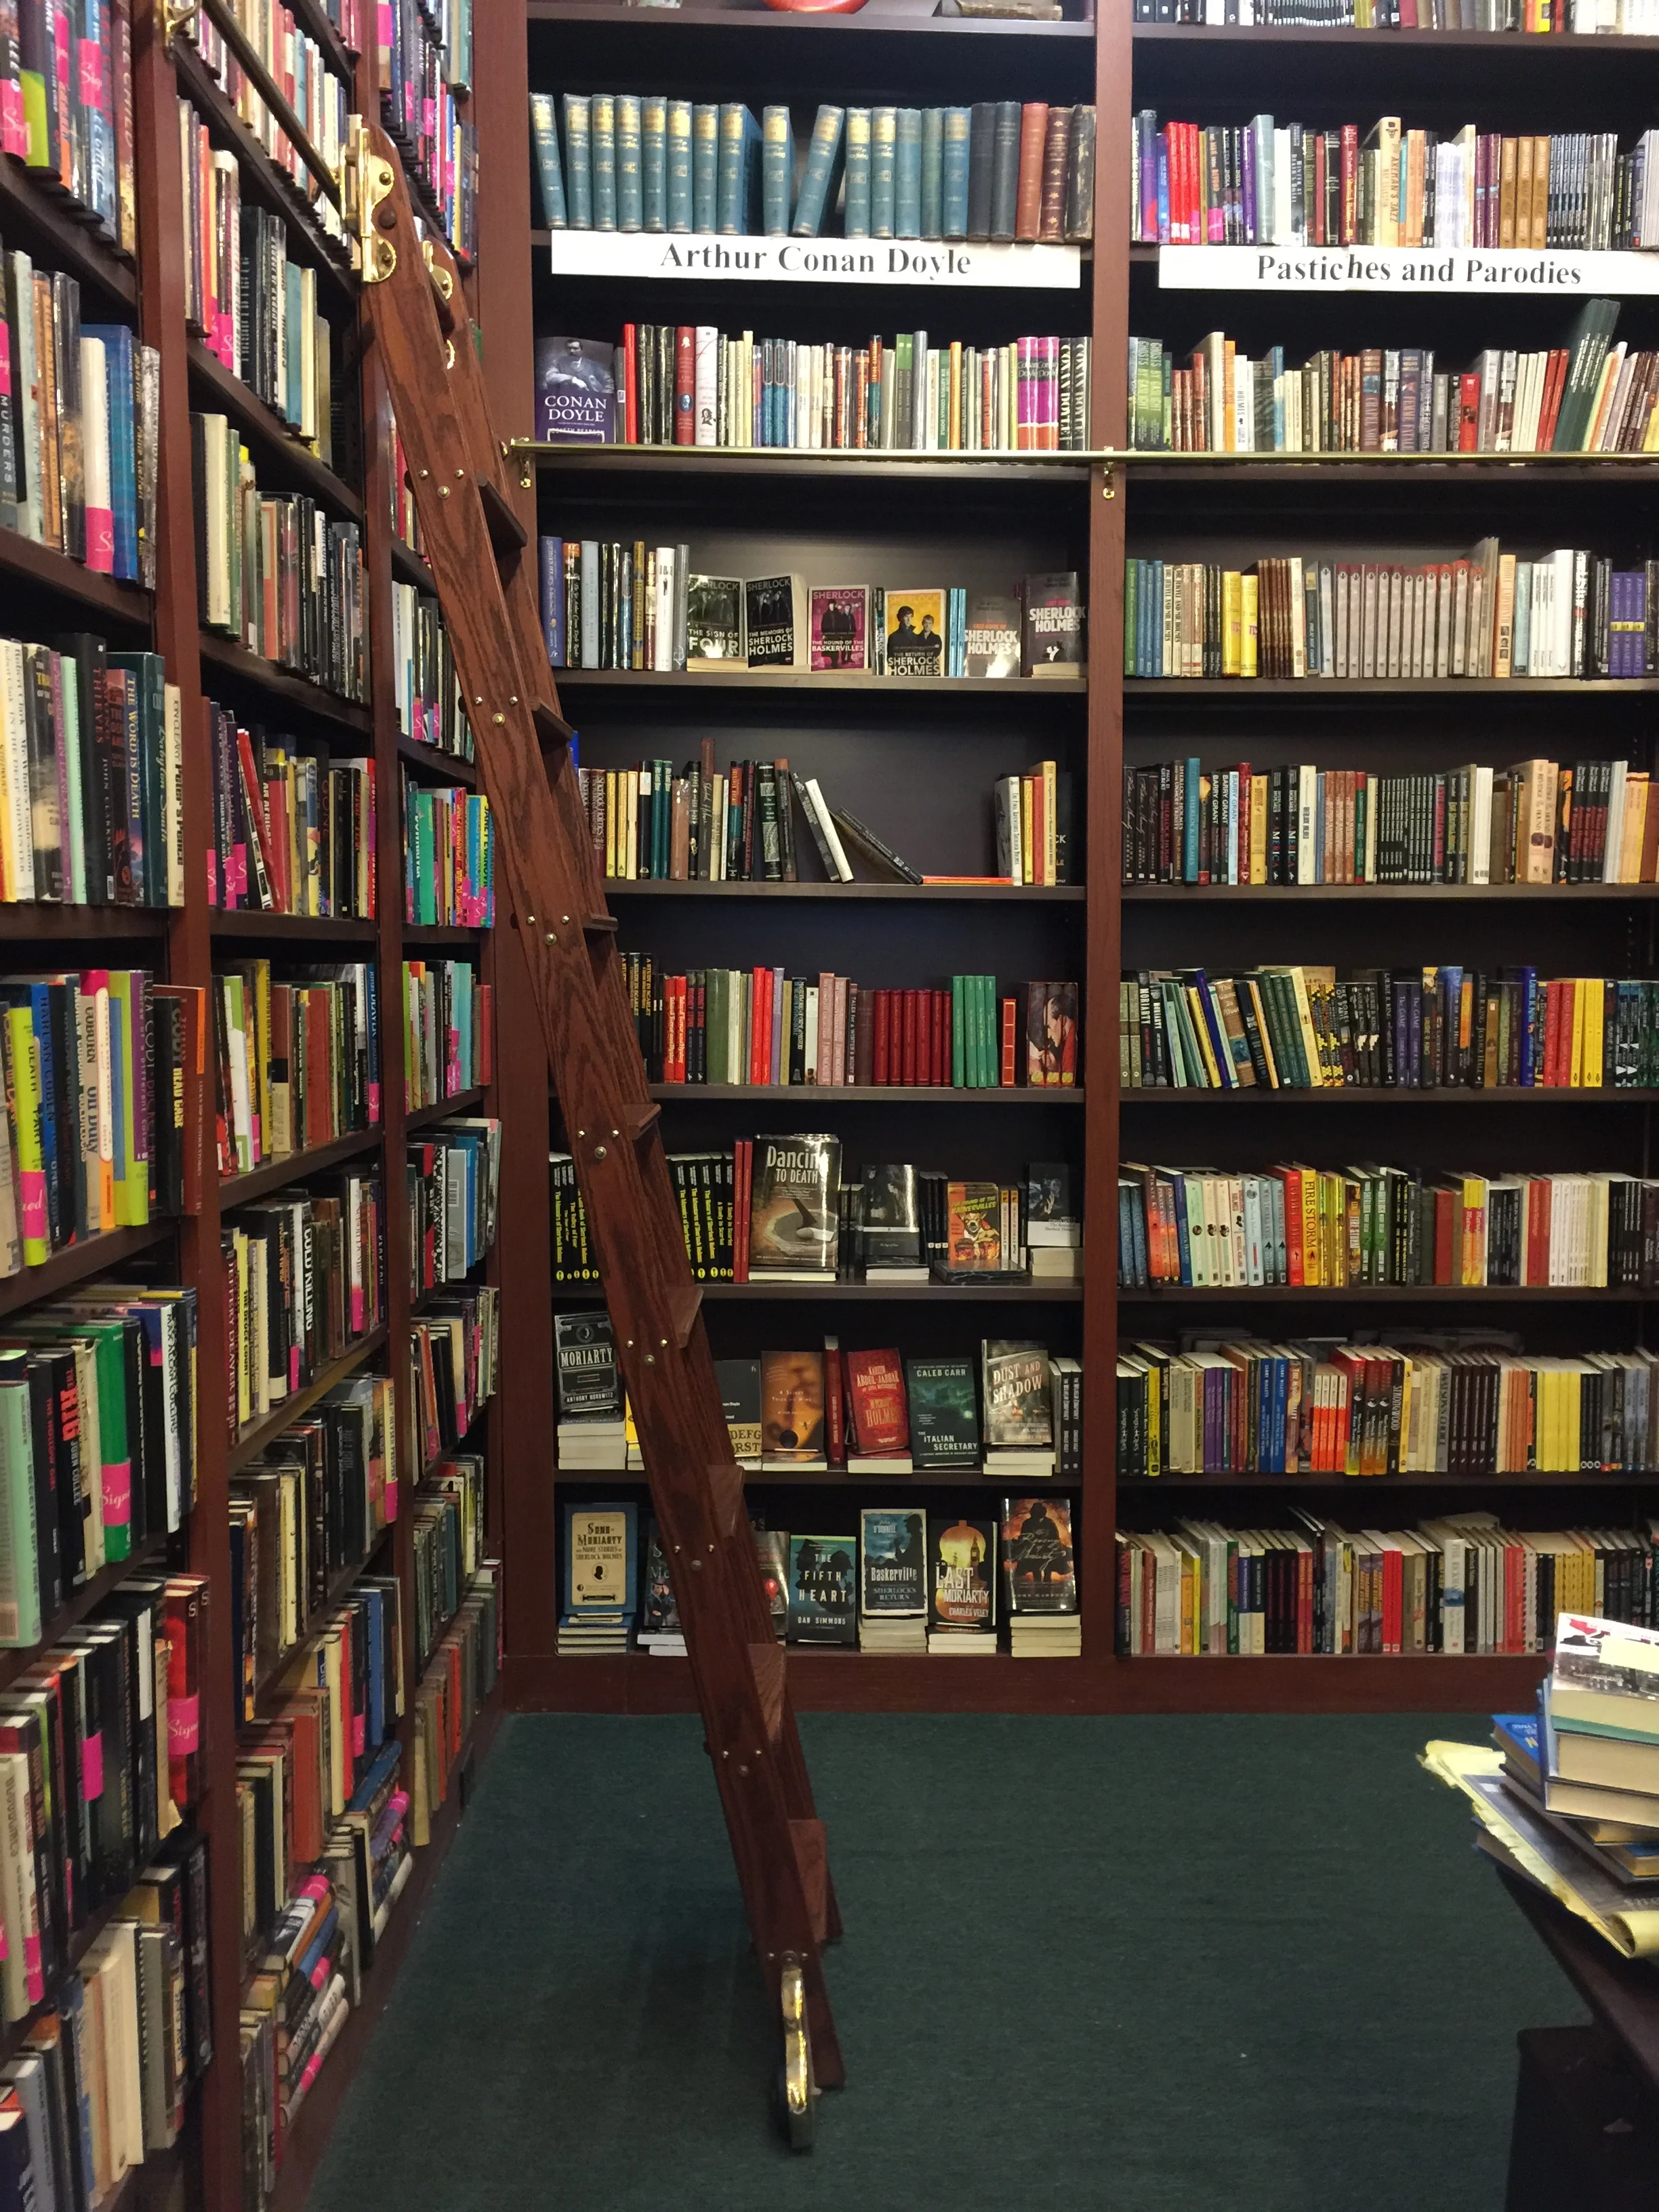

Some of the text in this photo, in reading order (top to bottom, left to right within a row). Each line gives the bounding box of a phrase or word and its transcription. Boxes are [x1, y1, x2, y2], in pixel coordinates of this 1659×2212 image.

[659, 242, 972, 281] Arthur Conan Doyle
[1257, 253, 1582, 285] Pastiches and Parodies
[544, 395, 607, 409] CONAN
[548, 409, 605, 422] DOYLE
[746, 578, 792, 592] SHERLOCK
[813, 590, 864, 600] SHERLOCK
[1029, 607, 1086, 621] SHERLOCK
[1035, 617, 1080, 633] HOLMES
[748, 633, 793, 646] SHERLOCK
[964, 629, 1017, 643] SHERLOCK
[748, 642, 793, 657] HOLMES
[888, 656, 939, 666] SHERLOCK
[888, 665, 940, 676] HOLMES
[127, 678, 140, 818] THE WORD IS DEATH
[1288, 823, 1296, 867] AMERICA
[1139, 988, 1151, 1024] MORIARTY
[1153, 1002, 1162, 1029] MORIARTY
[85, 1006, 96, 1063] COBURN
[776, 1168, 818, 1185] TO DEATH
[1305, 1181, 1316, 1248] FIRE STORM
[561, 1347, 613, 1368] MORIARTY
[916, 1368, 966, 1377] CALEB CARR
[993, 1361, 1041, 1385] DUST AND
[992, 1374, 1042, 1404] SHADOW
[60, 1387, 79, 1441] RIG
[924, 1435, 955, 1443] ITALIAN
[933, 1442, 978, 1451] SECRETARY
[815, 1554, 832, 1563] THE
[805, 1571, 842, 1582] FIFTH
[871, 1567, 918, 1582] Baskerville
[936, 1565, 974, 1589] LAST
[798, 1590, 847, 1603] HEART
[944, 1590, 989, 1603] MORIARTY
[798, 1616, 846, 1625] DAN SIMMONS
